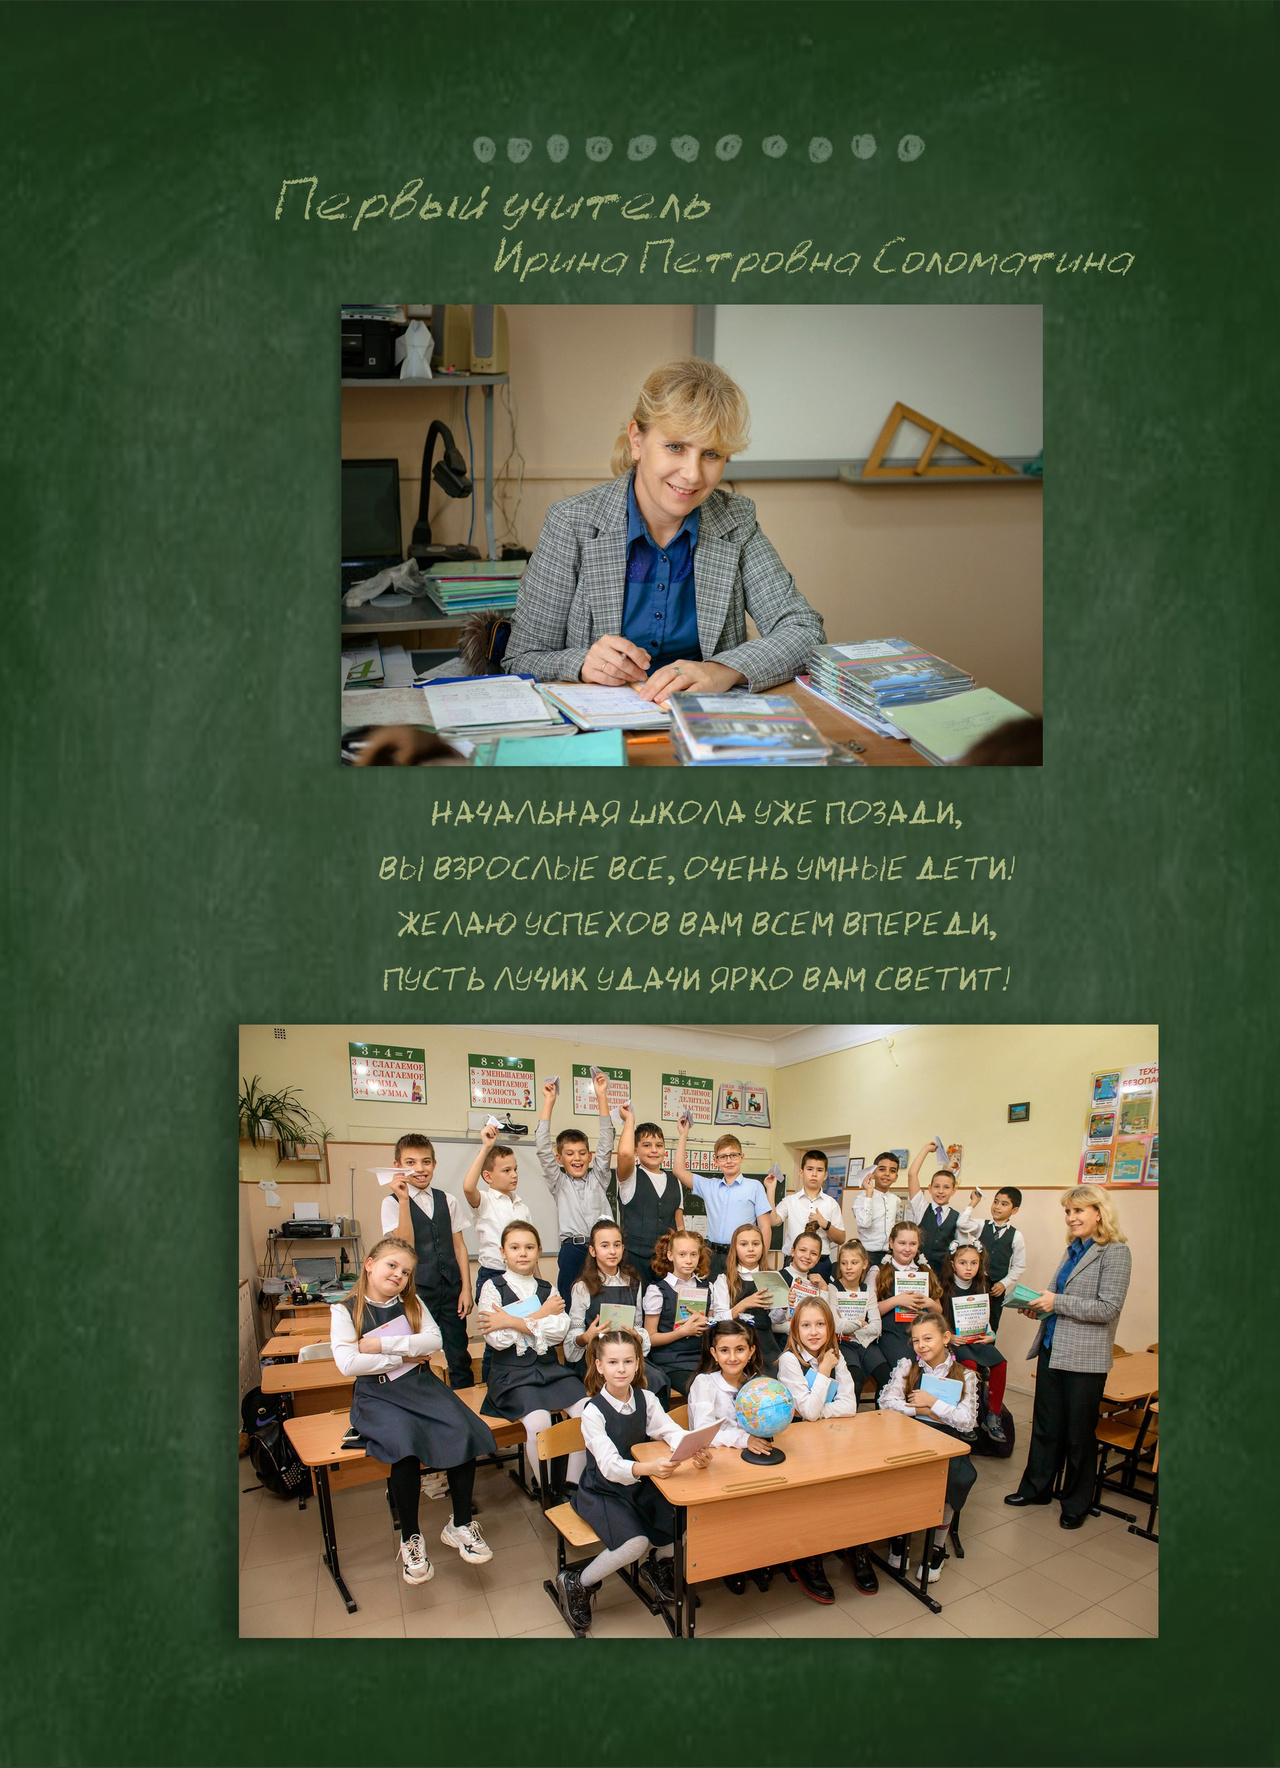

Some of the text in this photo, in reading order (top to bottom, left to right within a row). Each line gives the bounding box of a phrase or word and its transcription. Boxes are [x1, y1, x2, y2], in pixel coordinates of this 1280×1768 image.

[349, 659, 376, 679] 4
[362, 1046, 369, 1055] 3
[384, 1049, 391, 1057] 4
[406, 1051, 413, 1059] 7
[372, 1060, 424, 1071] СЛАГАЕМОЕ
[481, 1057, 487, 1066] 8
[498, 1059, 504, 1067] 3
[517, 1061, 523, 1069] 5
[372, 1070, 424, 1080] СЛАГАЕМОЕ
[481, 1069, 534, 1080] УМЕНЬШАЕМОЕ
[581, 1067, 587, 1075] 3
[613, 1070, 623, 1079] 12
[482, 1079, 528, 1088] ВЫЧИТАЕМОЕ
[670, 1077, 680, 1085] 28
[377, 1089, 408, 1098] СУММА
[482, 1088, 517, 1096] РАЗНОСТЬ
[681, 1089, 711, 1097] ДЕЛИМОЕ
[488, 1097, 522, 1106] РАЗНОСТЬ
[678, 1096, 711, 1105] ДЕЛИТЕЛЬ
